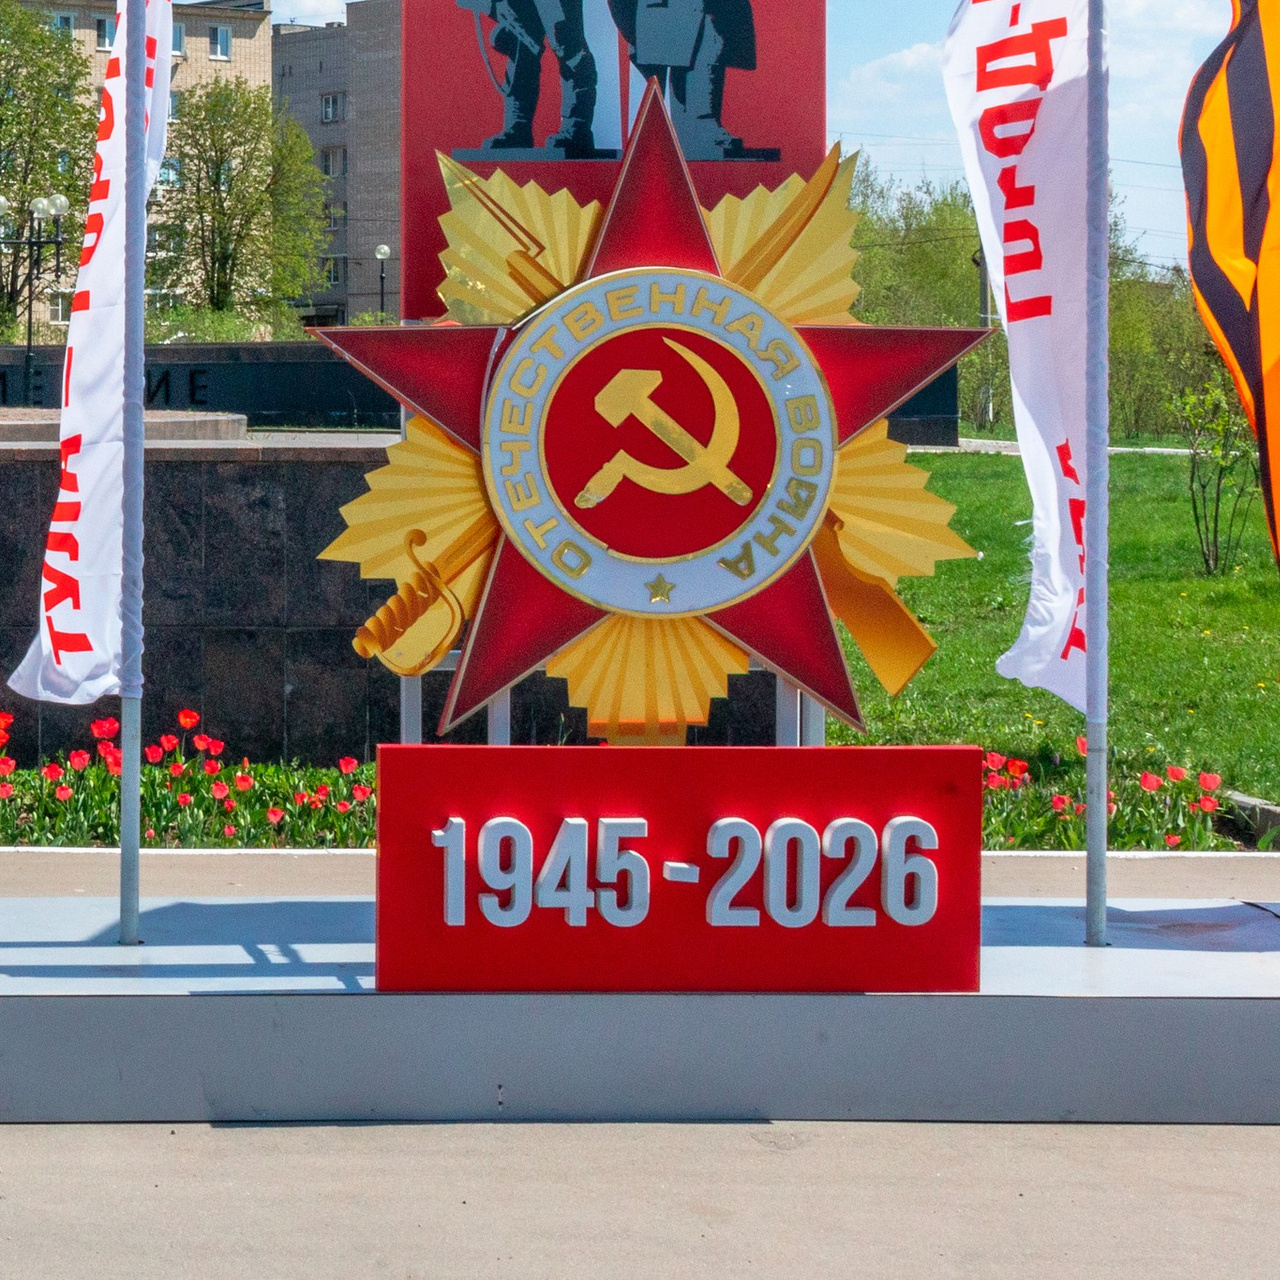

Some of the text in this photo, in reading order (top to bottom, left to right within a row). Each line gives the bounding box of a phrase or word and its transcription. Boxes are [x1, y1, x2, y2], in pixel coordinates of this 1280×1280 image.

[500, 282, 802, 579] ОТЕЧЕСТВЕННАЯ
[41, 433, 94, 665] ТУЛА
[431, 815, 940, 928] 1945-2026
